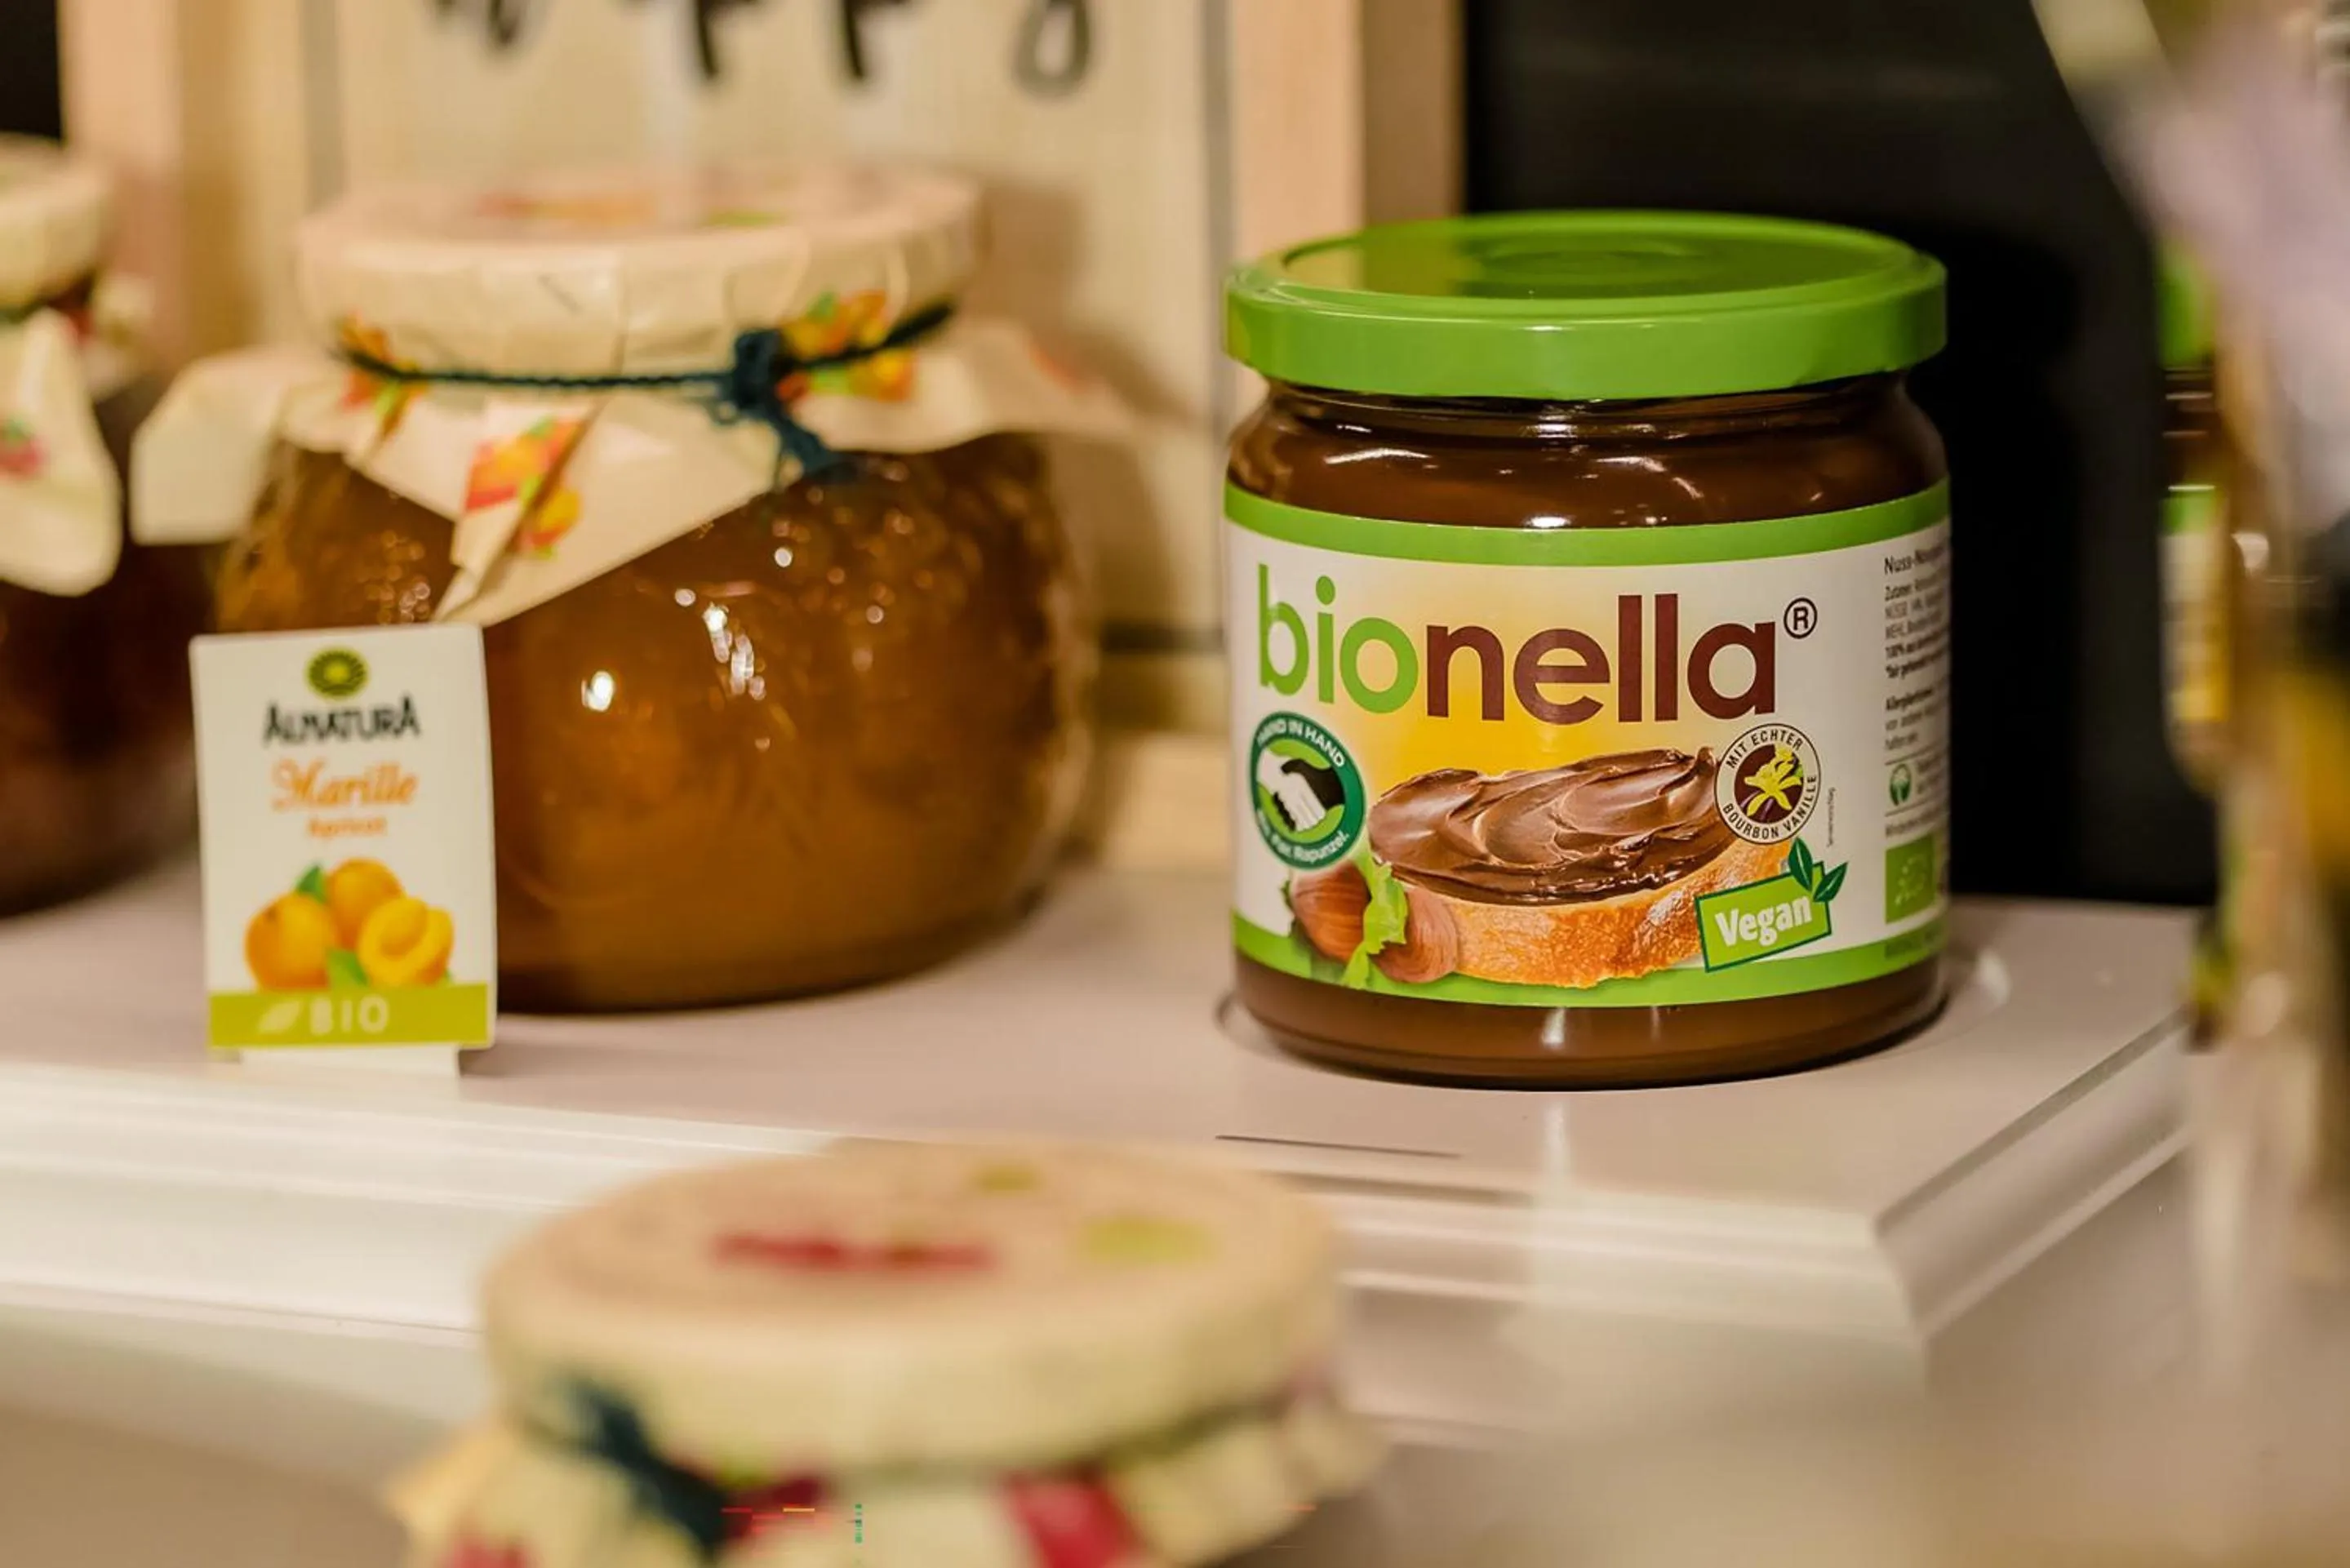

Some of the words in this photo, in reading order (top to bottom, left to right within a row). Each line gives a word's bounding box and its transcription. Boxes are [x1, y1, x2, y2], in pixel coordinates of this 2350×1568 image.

[1305, 726, 1346, 768] HAND
[1726, 742, 1748, 768] MIT
[1751, 729, 1804, 751] ECHTER
[271, 757, 419, 812] Marille
[1722, 802, 1779, 840] BOURBON
[1782, 775, 1817, 833] VANILLE
[1715, 895, 1813, 947] Vegan
[309, 995, 389, 1036] BIO
